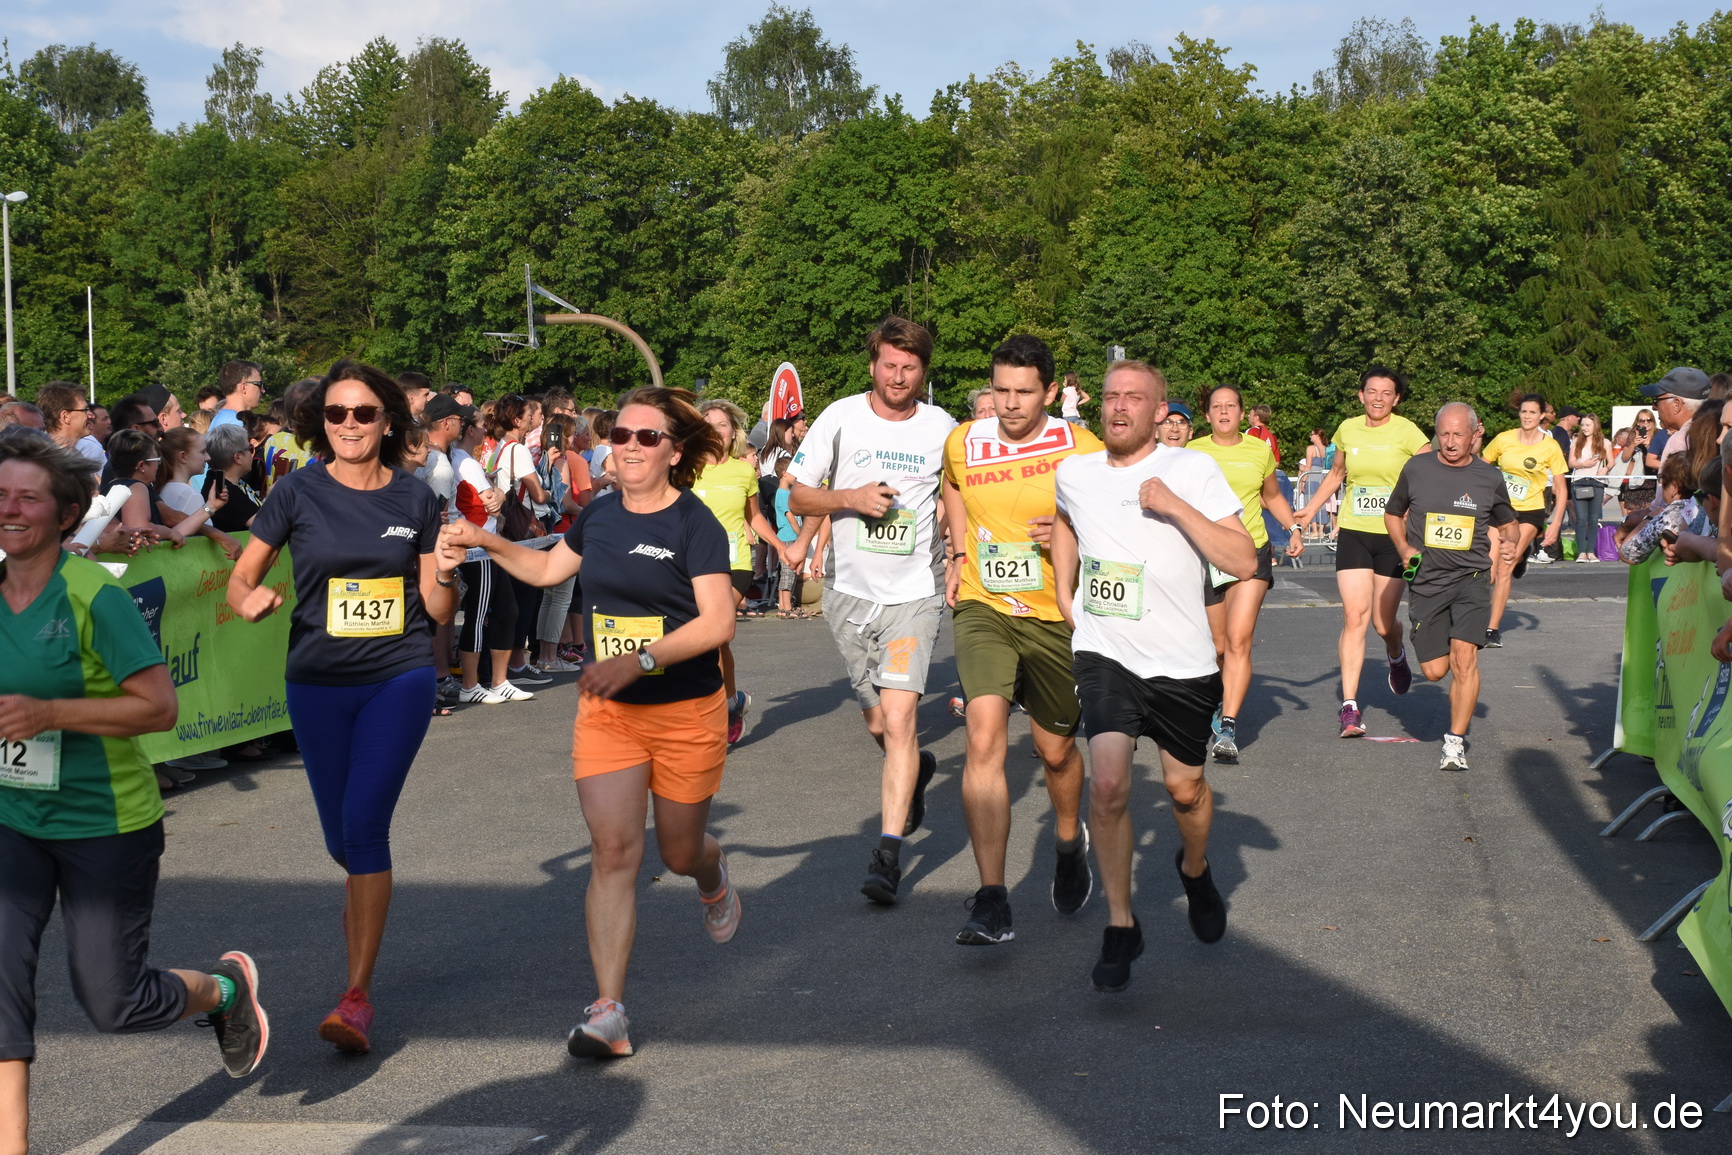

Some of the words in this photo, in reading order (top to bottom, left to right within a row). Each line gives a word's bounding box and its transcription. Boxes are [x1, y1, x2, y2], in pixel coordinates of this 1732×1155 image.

[875, 450, 926, 465] HAUBNER
[881, 461, 920, 473] TREPPEN
[965, 468, 1014, 487] MAX
[1504, 480, 1524, 494] 761
[1357, 497, 1386, 508] 1208
[865, 523, 909, 541] 1007
[1435, 526, 1462, 540] 426
[985, 559, 1030, 578] 1621
[1090, 578, 1125, 602] 660
[339, 599, 395, 620] 1437
[1103, 600, 1128, 609] Christian
